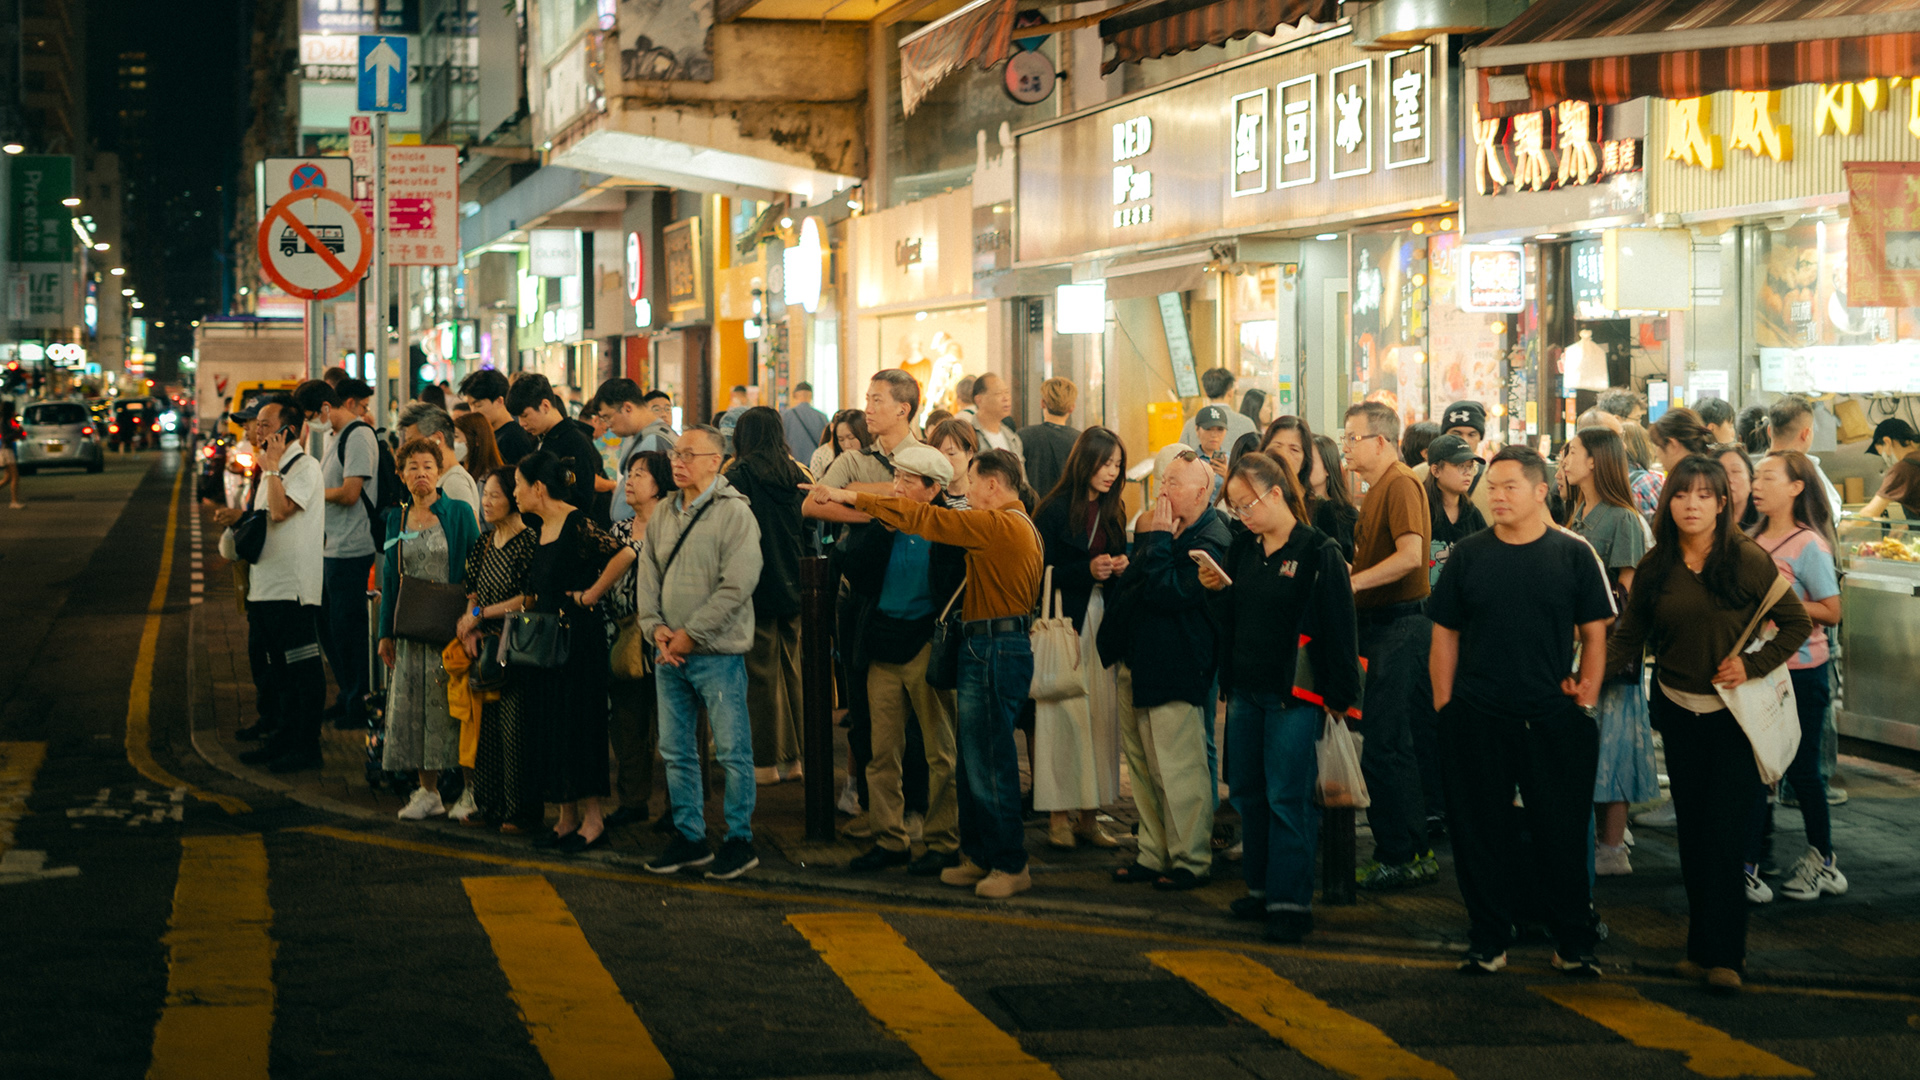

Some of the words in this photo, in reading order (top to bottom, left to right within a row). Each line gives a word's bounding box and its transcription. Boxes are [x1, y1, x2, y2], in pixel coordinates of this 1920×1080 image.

[1112, 115, 1152, 162] RED
[390, 152, 425, 161] ehicle
[409, 165, 429, 174] will
[432, 165, 446, 174] be
